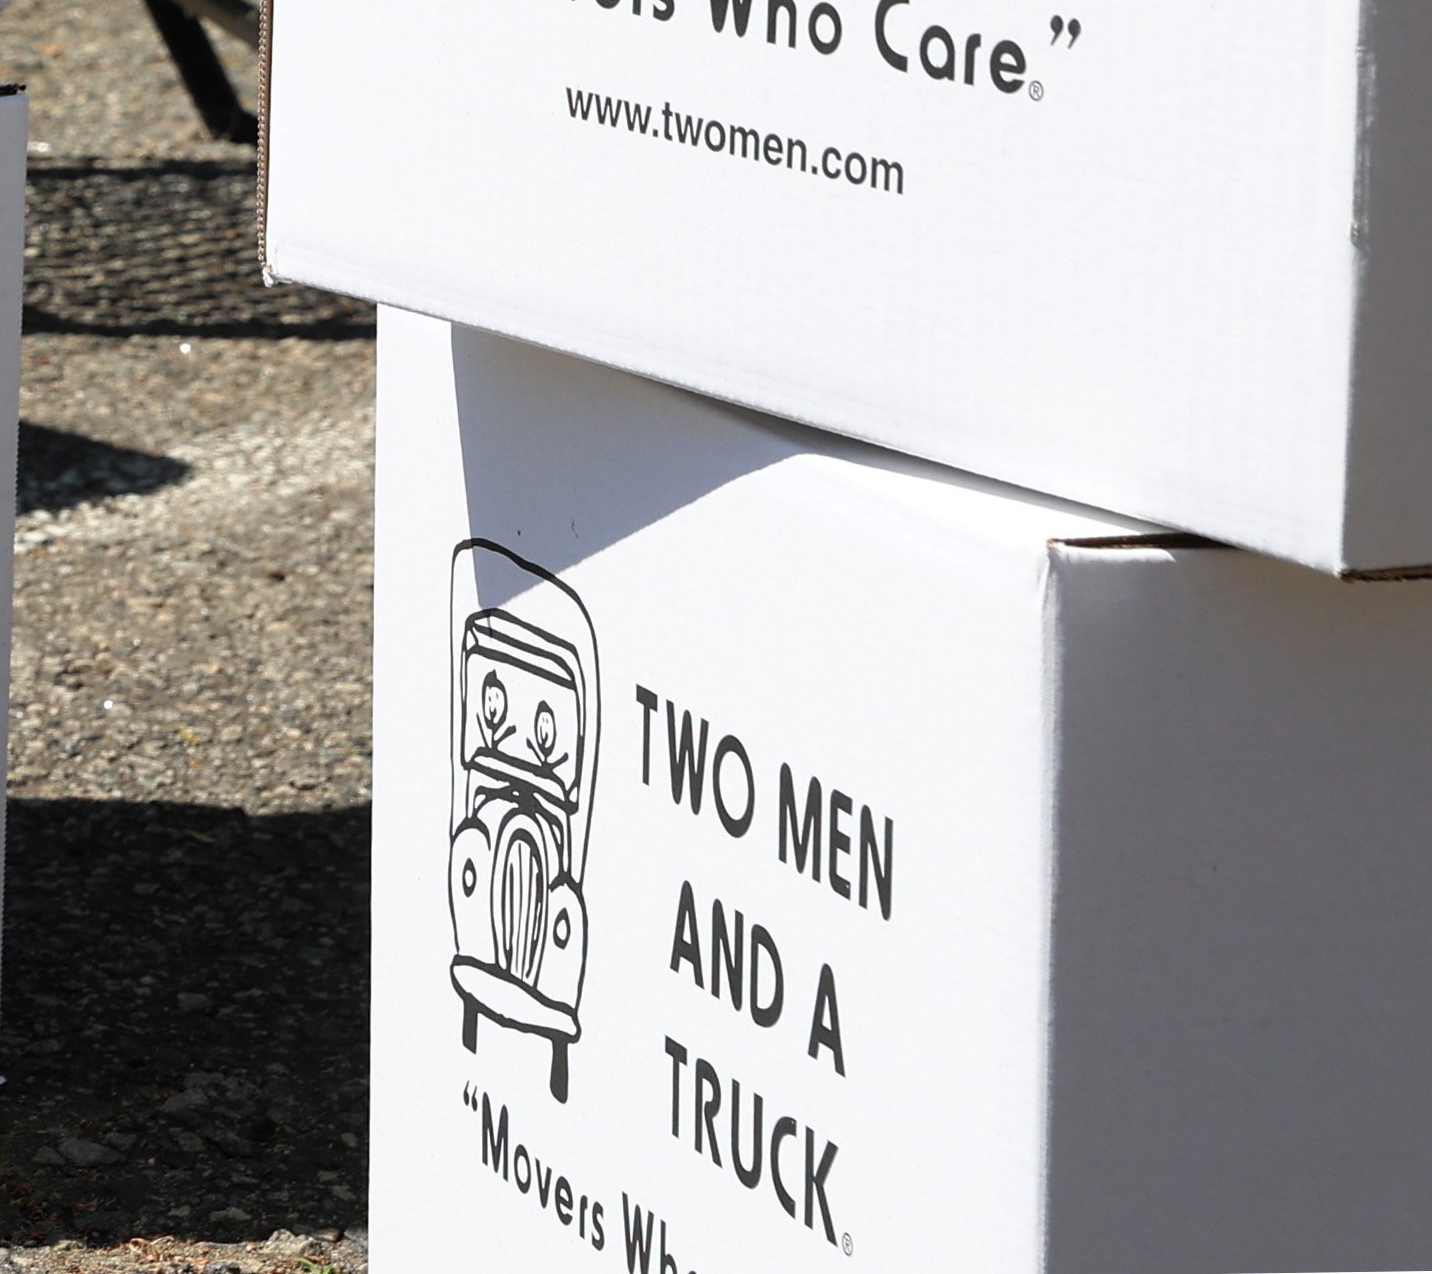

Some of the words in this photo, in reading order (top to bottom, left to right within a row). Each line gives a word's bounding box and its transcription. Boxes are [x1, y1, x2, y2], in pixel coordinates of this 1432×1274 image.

[566, 87, 904, 195] www.twomen.com
[636, 684, 755, 838] TWO
[779, 762, 893, 921] MEN
[670, 880, 784, 1028] AND
[808, 963, 845, 1077] A
[463, 1081, 605, 1251] “Movers
[622, 1192, 696, 1274] Wh
